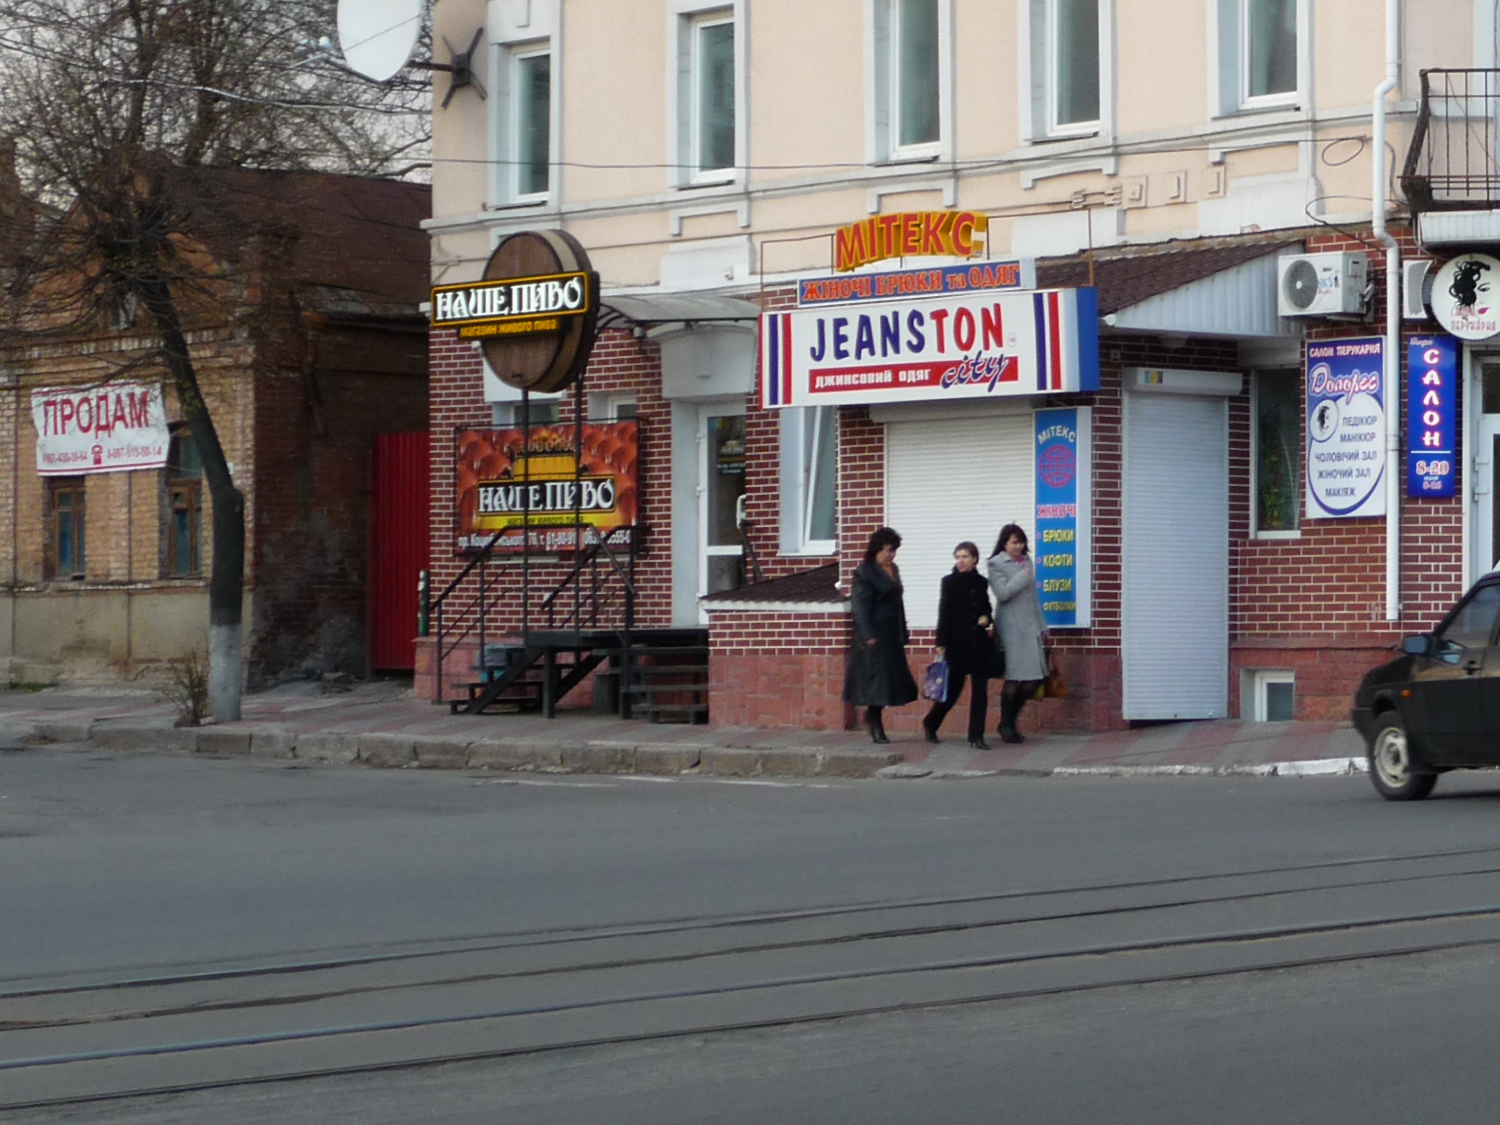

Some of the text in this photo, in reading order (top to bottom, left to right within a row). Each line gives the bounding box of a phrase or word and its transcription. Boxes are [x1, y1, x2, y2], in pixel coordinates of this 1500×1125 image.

[835, 210, 977, 272] МІТЕКС
[802, 277, 871, 301] ЖІНОЧІ
[875, 271, 943, 296] БРЮКИ
[968, 263, 1021, 288] ОДЯГ
[436, 276, 581, 321] НАШЕ ПИВО
[810, 303, 1004, 362] JEANSTON
[1336, 343, 1381, 355] ПЕРУКАРНЯ
[941, 350, 1010, 393] city
[1312, 366, 1377, 405] Долорес
[1422, 348, 1441, 447] САЛОН
[43, 390, 150, 440] ПРОДАМ
[1038, 425, 1076, 444] МІТЕКС
[1340, 433, 1376, 443] МАНІКЮР
[1315, 450, 1377, 463] ЧОЛОВІЧИЙ ЗАЛ
[1317, 467, 1371, 479] ЖІНОЧИЙ ЗАЛ
[1416, 460, 1450, 475] 8-20
[1325, 487, 1355, 497] МАКІЯЖ
[1037, 503, 1078, 519] ЖІНОЧІ
[1043, 529, 1074, 543] БРЮКИ
[1043, 554, 1073, 568] КОФТИ
[1043, 578, 1072, 592] БЛУЗИ
